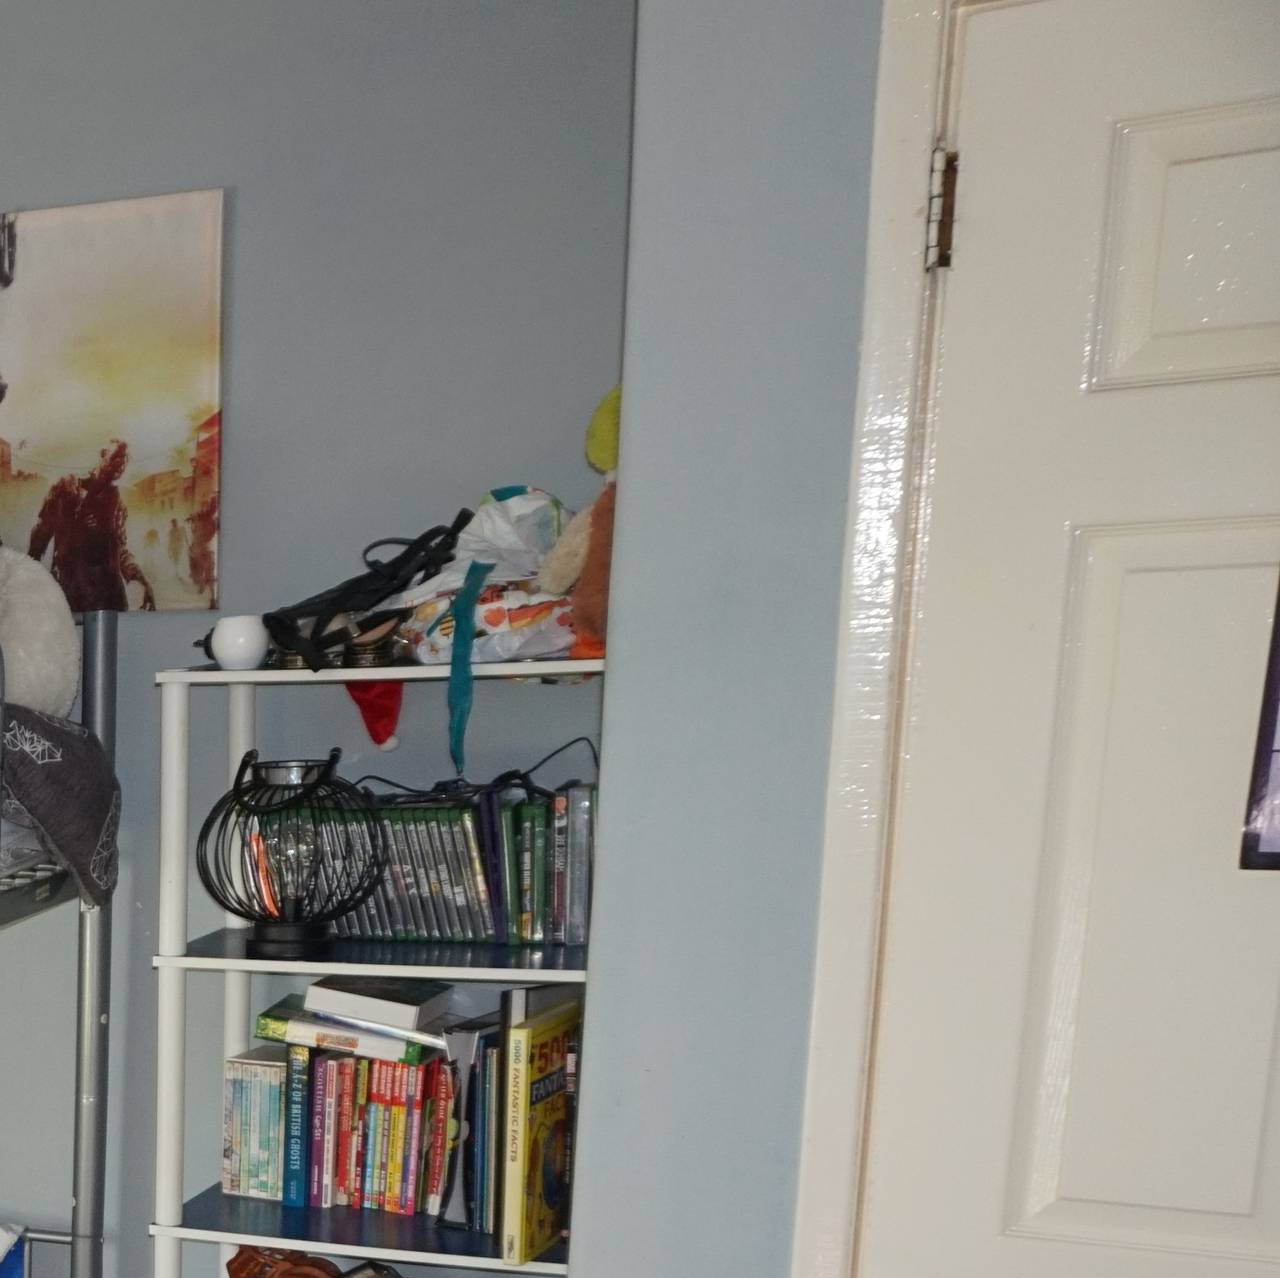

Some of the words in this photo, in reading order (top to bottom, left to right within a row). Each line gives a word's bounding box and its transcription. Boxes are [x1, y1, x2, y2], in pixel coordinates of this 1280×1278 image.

[291, 1090, 303, 1101] OF
[511, 1067, 521, 1127] FANTASTIC
[290, 1104, 302, 1136] BRITISH
[290, 1138, 301, 1170] GHOSTS
[510, 1130, 519, 1162] FACTS
